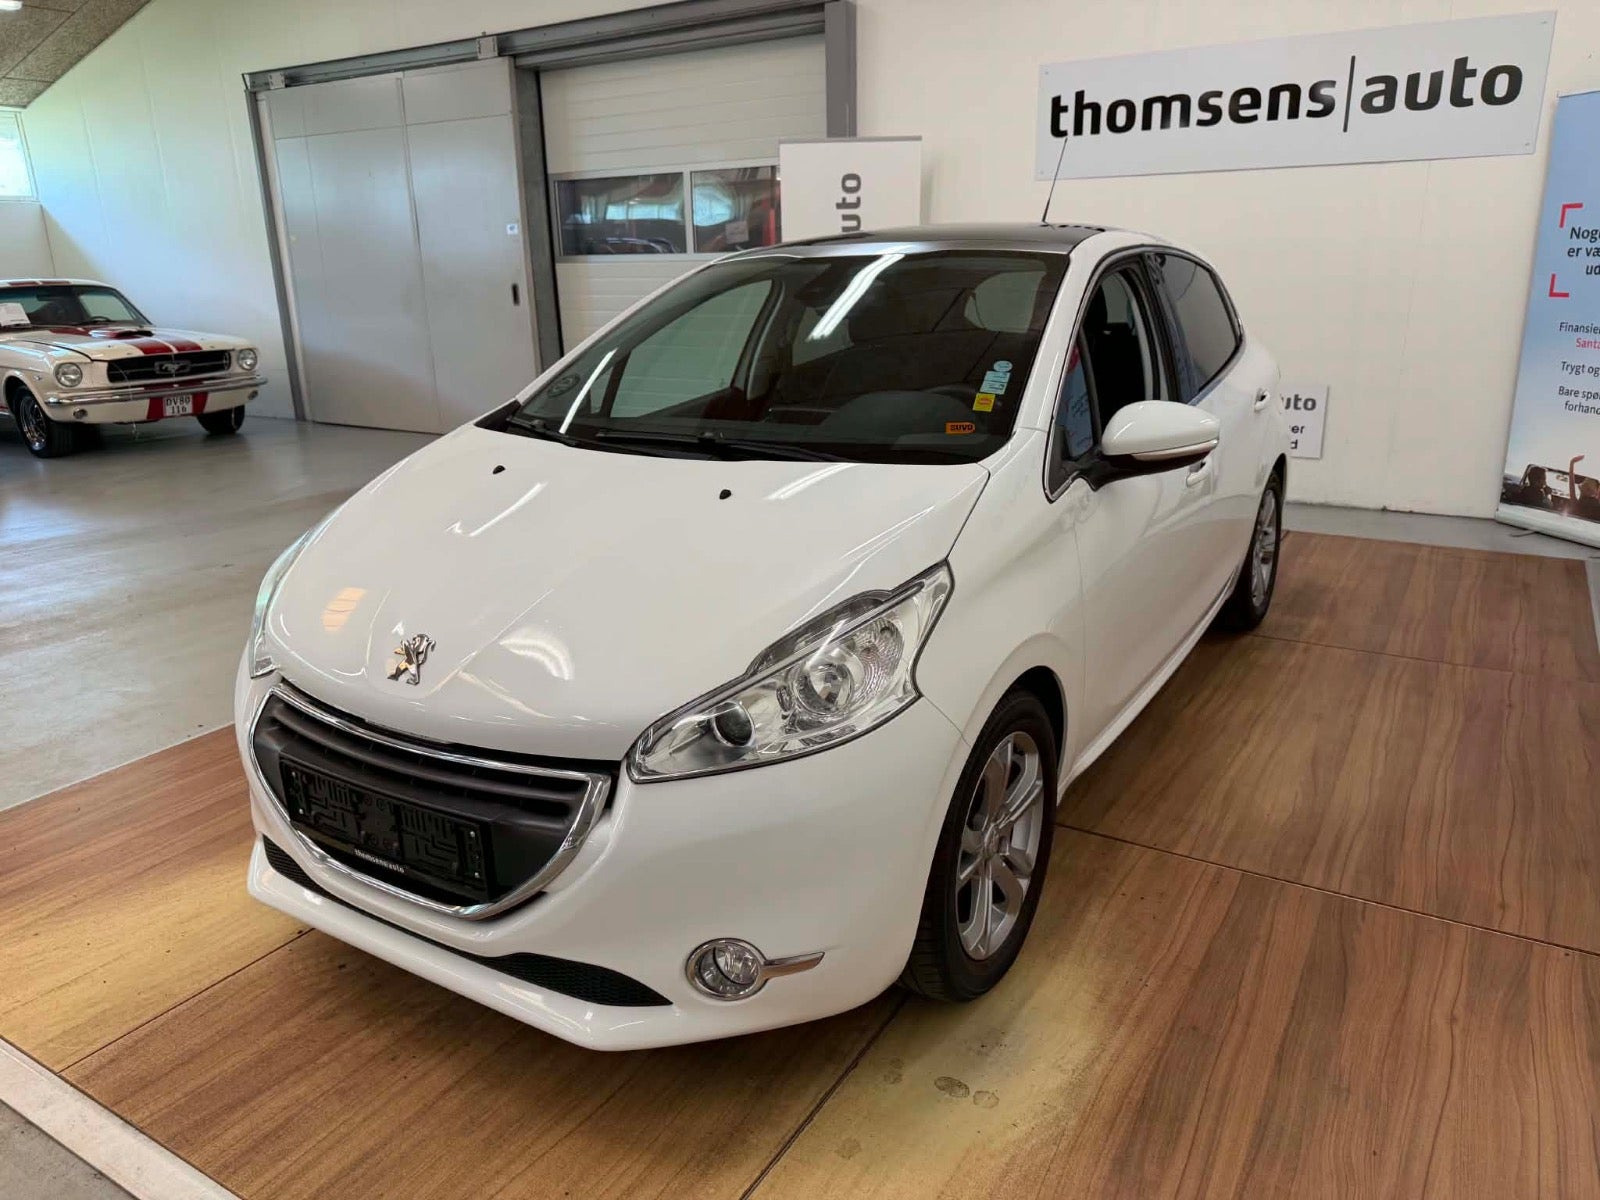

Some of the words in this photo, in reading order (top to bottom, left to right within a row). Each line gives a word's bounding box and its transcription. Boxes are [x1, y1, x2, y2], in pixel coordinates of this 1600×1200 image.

[1050, 79, 1337, 139] thomsens
[1360, 55, 1524, 114] auto
[1569, 226, 1600, 243] Nog
[1567, 247, 1582, 258] er
[1561, 360, 1585, 376] Trygt
[1558, 385, 1580, 398] Bare
[1289, 425, 1305, 434] er
